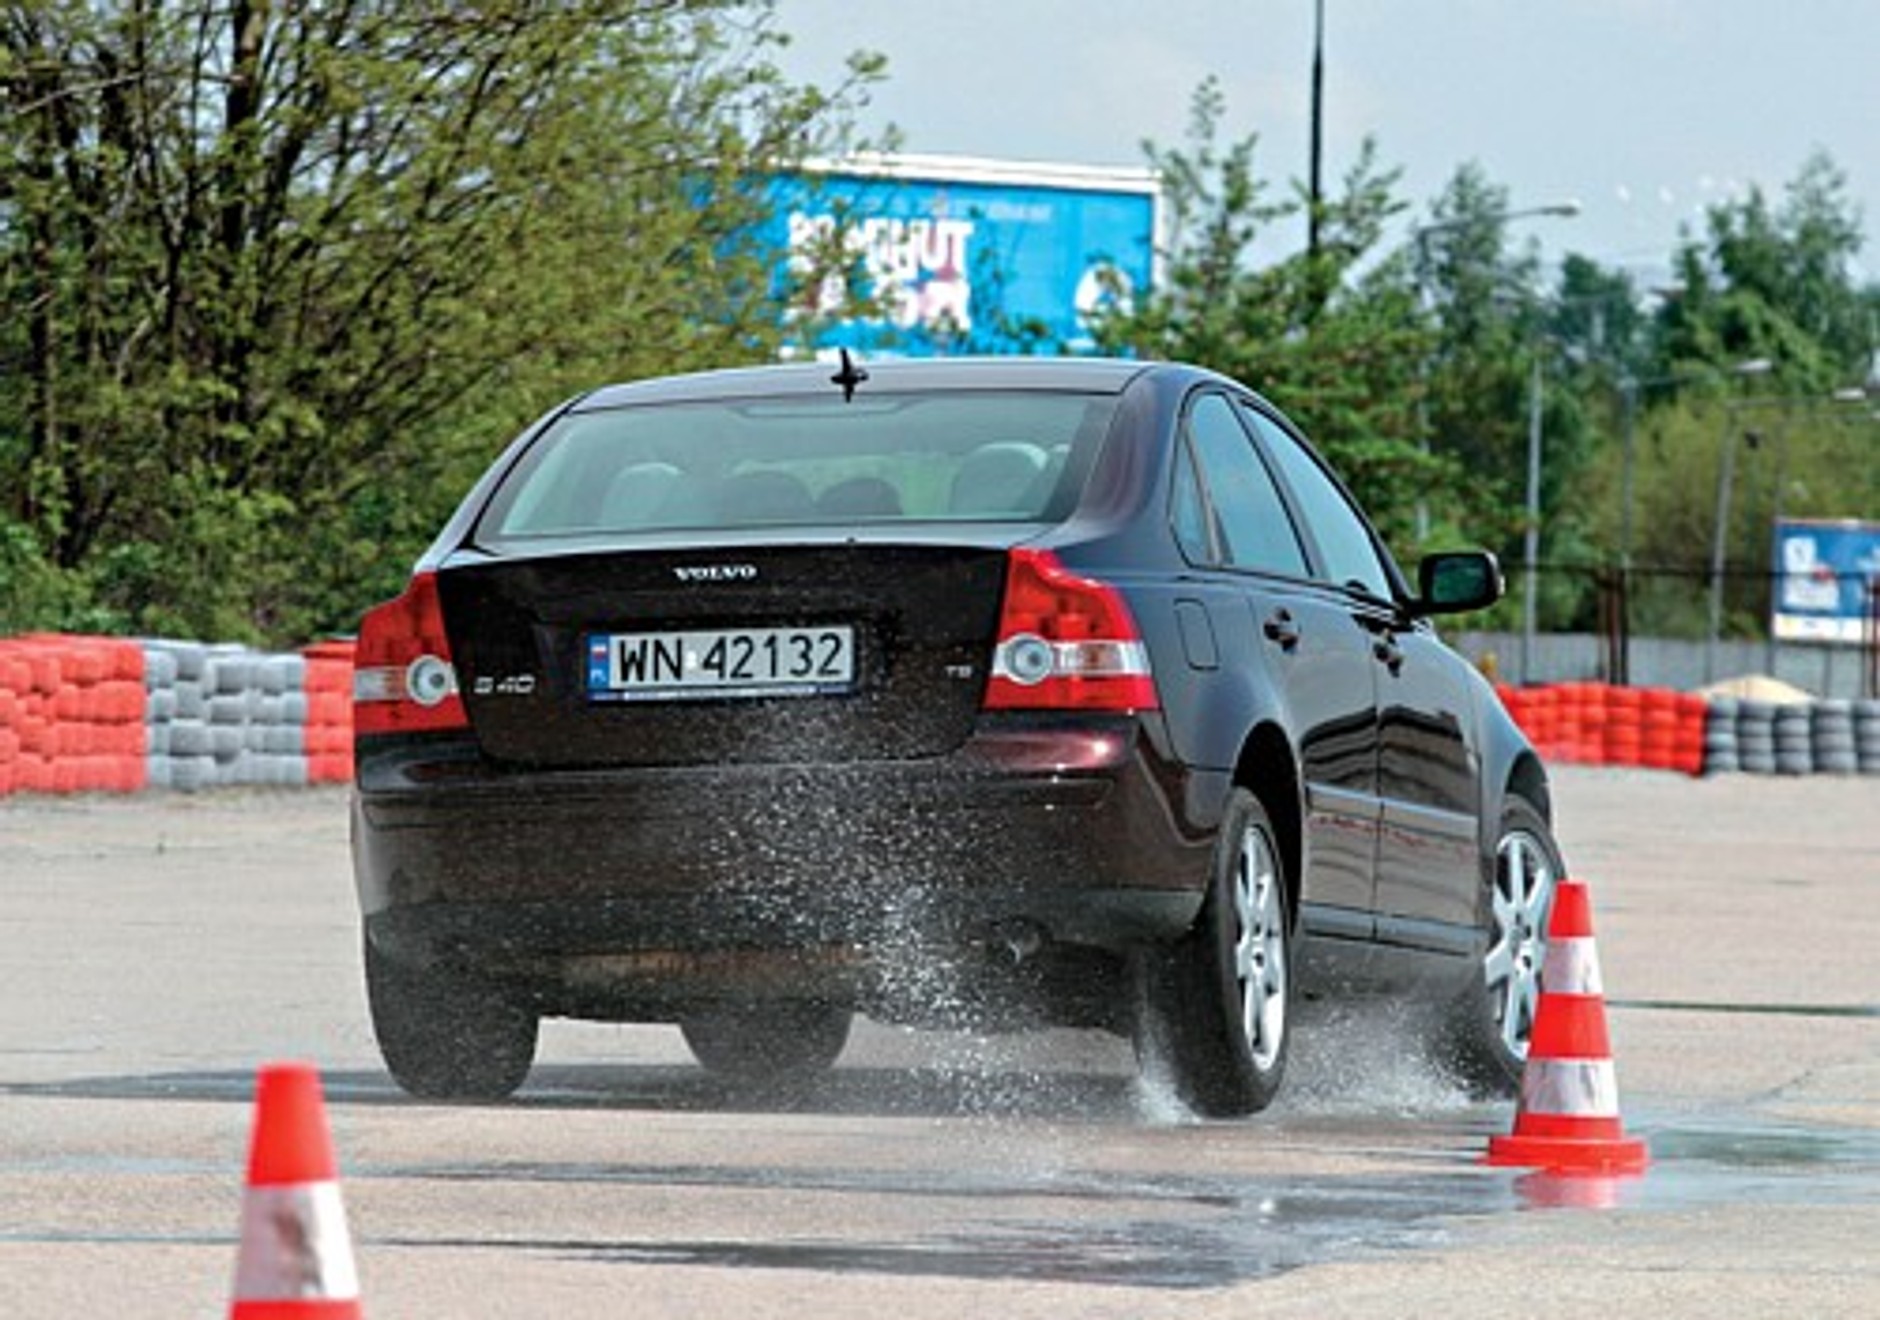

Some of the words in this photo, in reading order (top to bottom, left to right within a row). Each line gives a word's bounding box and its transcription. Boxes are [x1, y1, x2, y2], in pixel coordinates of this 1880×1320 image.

[673, 564, 757, 581] VOLVO
[620, 637, 682, 682] WN
[702, 632, 842, 679] 42132
